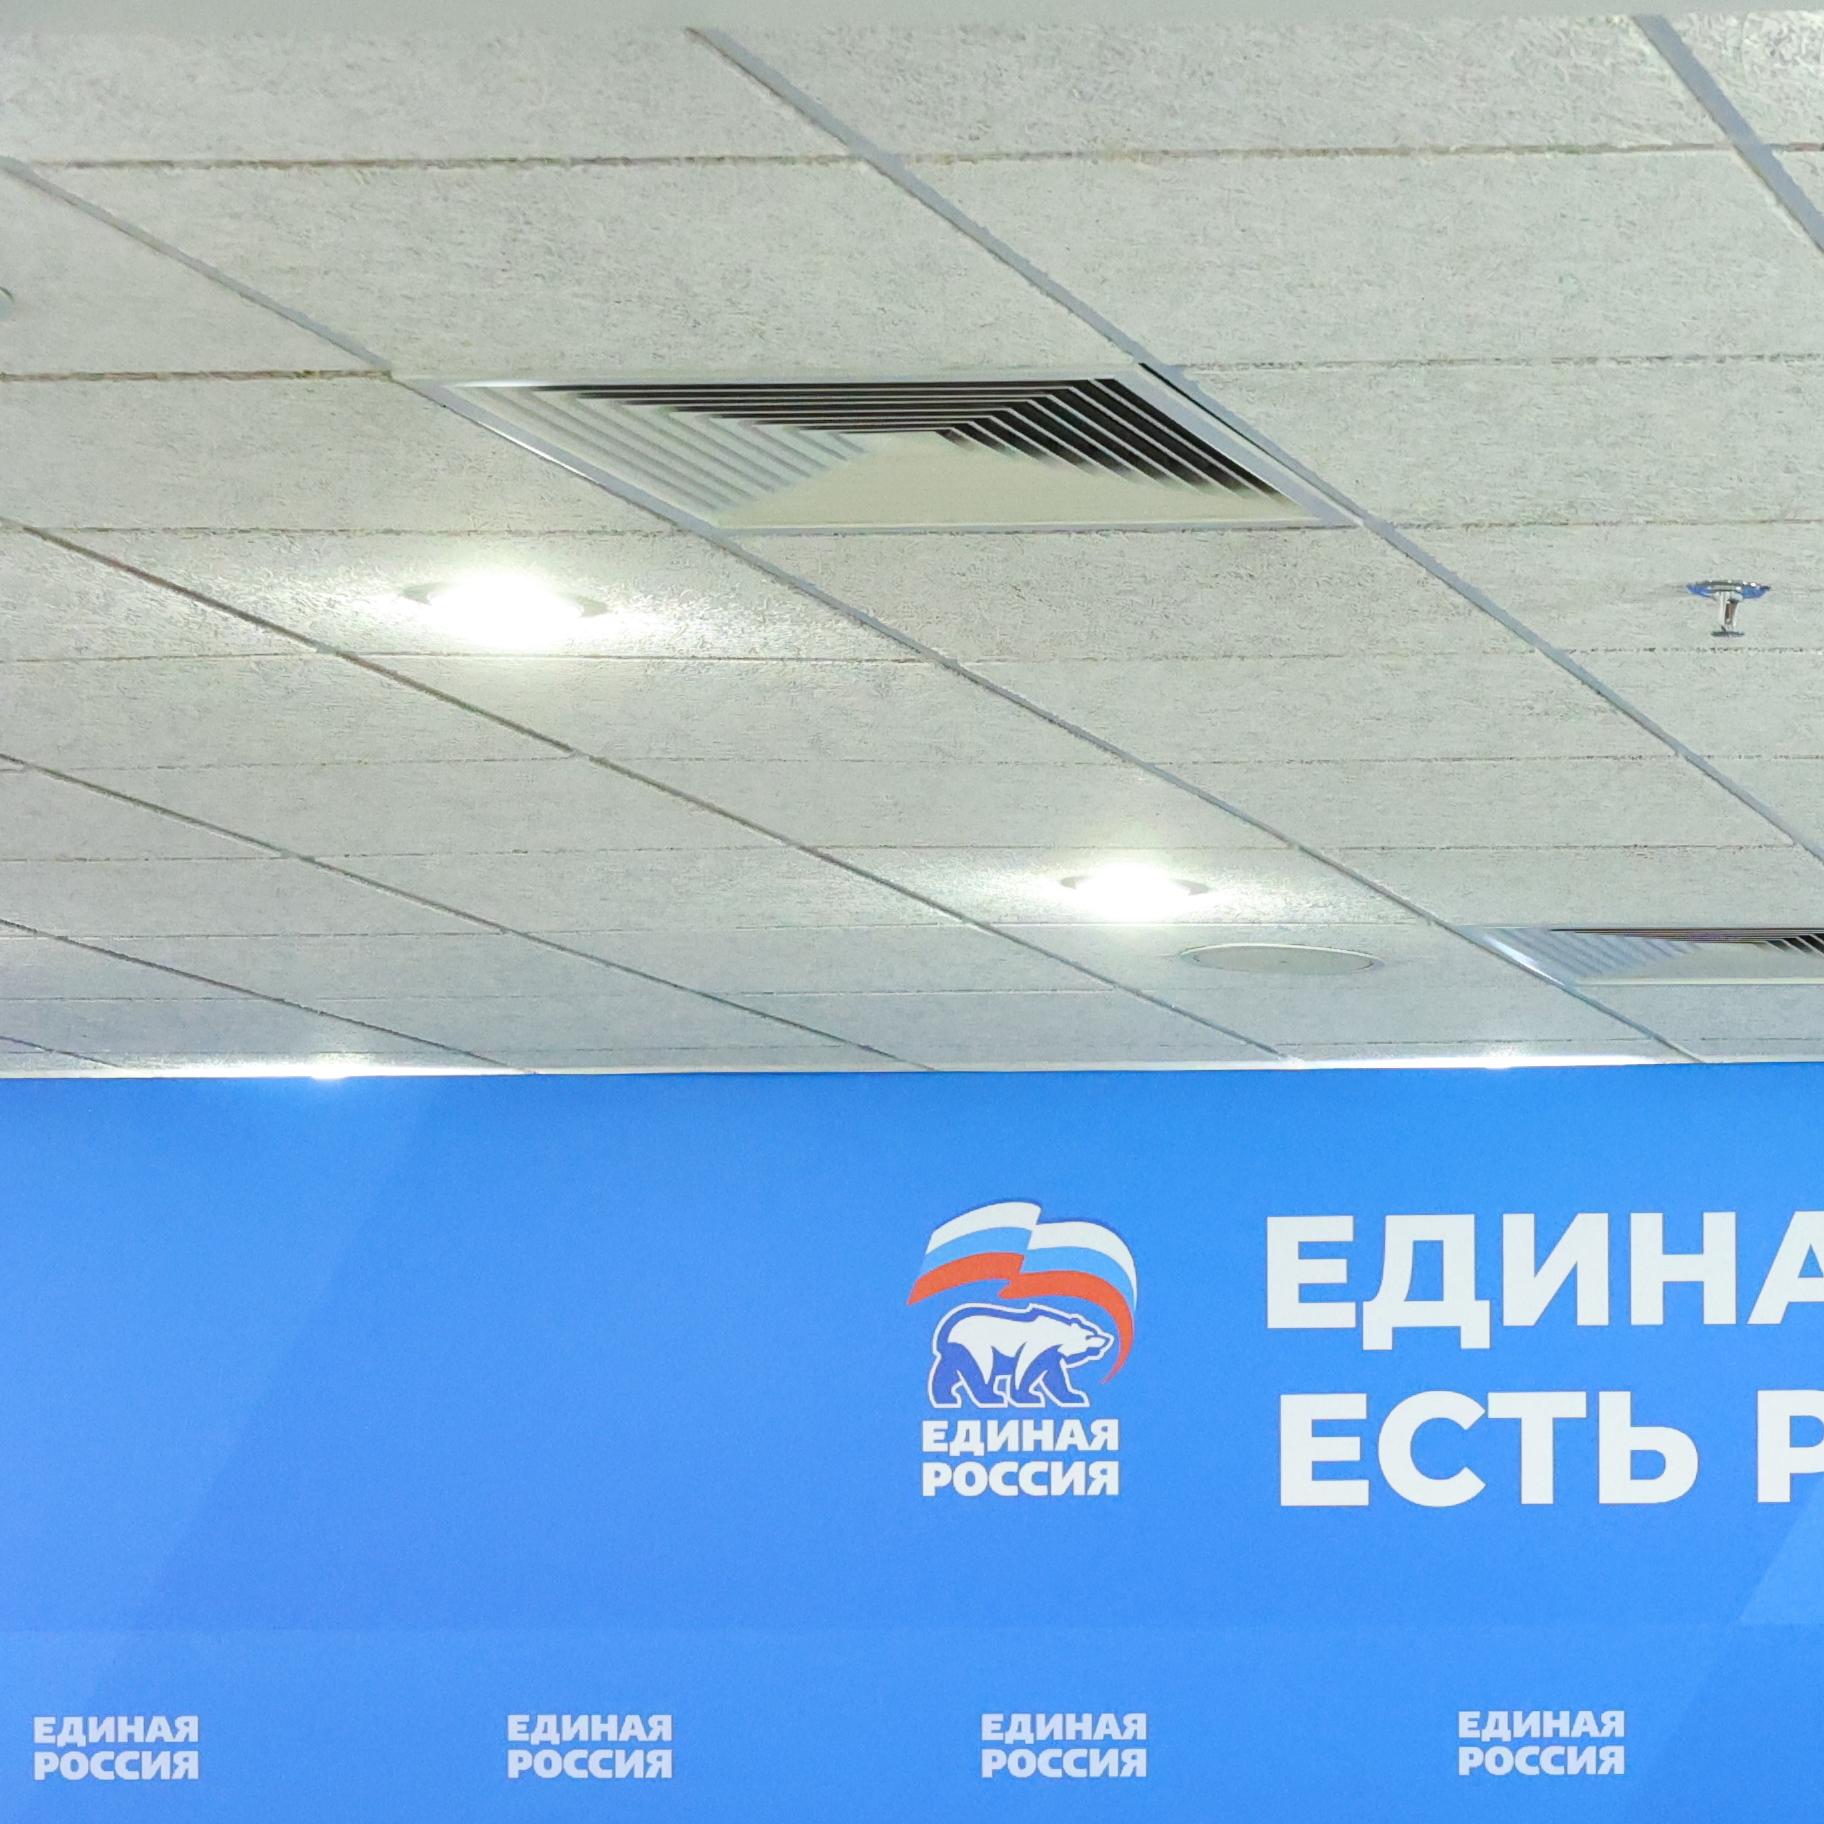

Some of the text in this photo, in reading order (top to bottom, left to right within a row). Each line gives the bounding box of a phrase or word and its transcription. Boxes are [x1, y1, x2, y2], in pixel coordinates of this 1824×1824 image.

[922, 1419, 1119, 1456] ЕДИНАЯ
[1280, 1391, 1698, 1507] ЕСТЬ
[923, 1461, 1119, 1496] РОССИЯ
[34, 1716, 198, 1747] ЕДИНАЯ
[508, 1715, 672, 1745] ЕДИНАЯ
[982, 1713, 1146, 1744] ЕДИНАЯ
[1459, 1711, 1624, 1741] ЕДИНАЯ
[34, 1751, 198, 1780] РОССИЯ
[508, 1749, 672, 1778] РОССИЯ
[982, 1749, 1146, 1777] РОССИЯ
[1459, 1746, 1624, 1775] РОССИЯ
